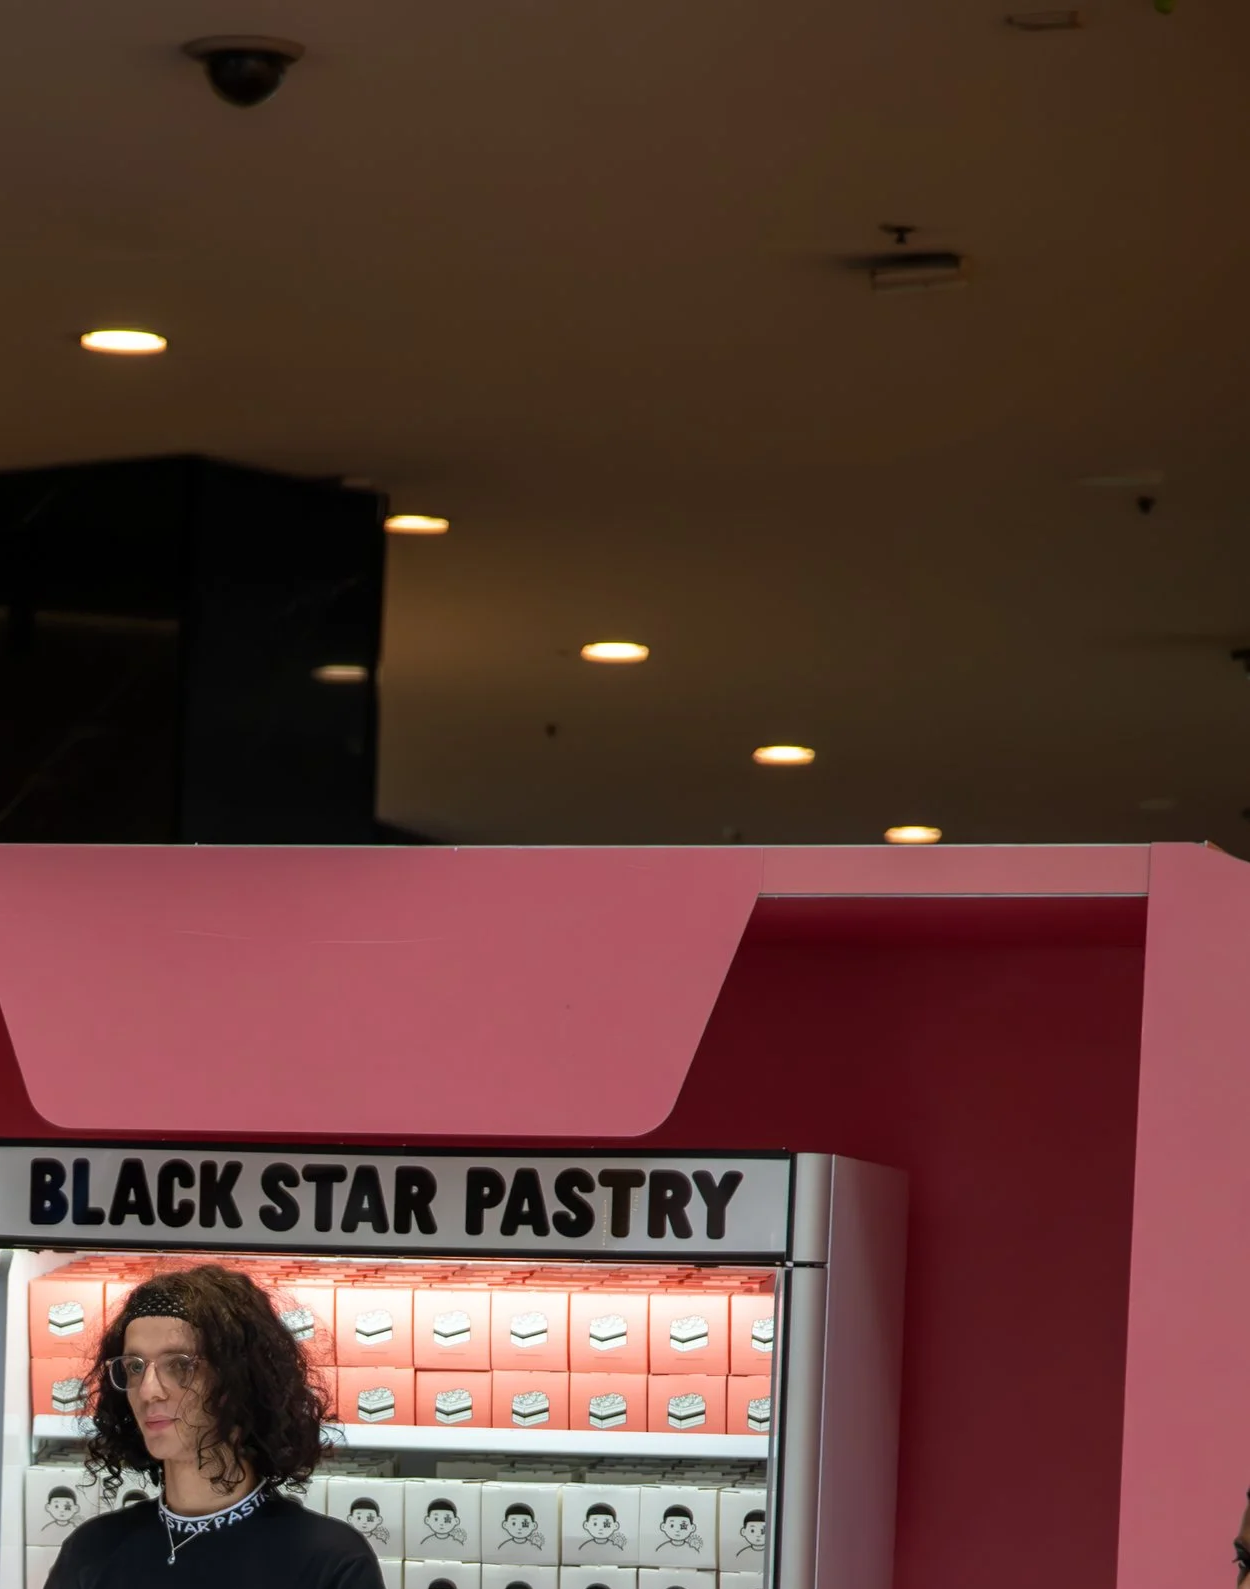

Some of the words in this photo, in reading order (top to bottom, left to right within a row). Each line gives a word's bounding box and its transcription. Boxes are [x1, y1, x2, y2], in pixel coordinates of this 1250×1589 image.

[29, 1157, 243, 1229] BLACK
[259, 1161, 438, 1235] STAR
[465, 1166, 744, 1240] PASTRY
